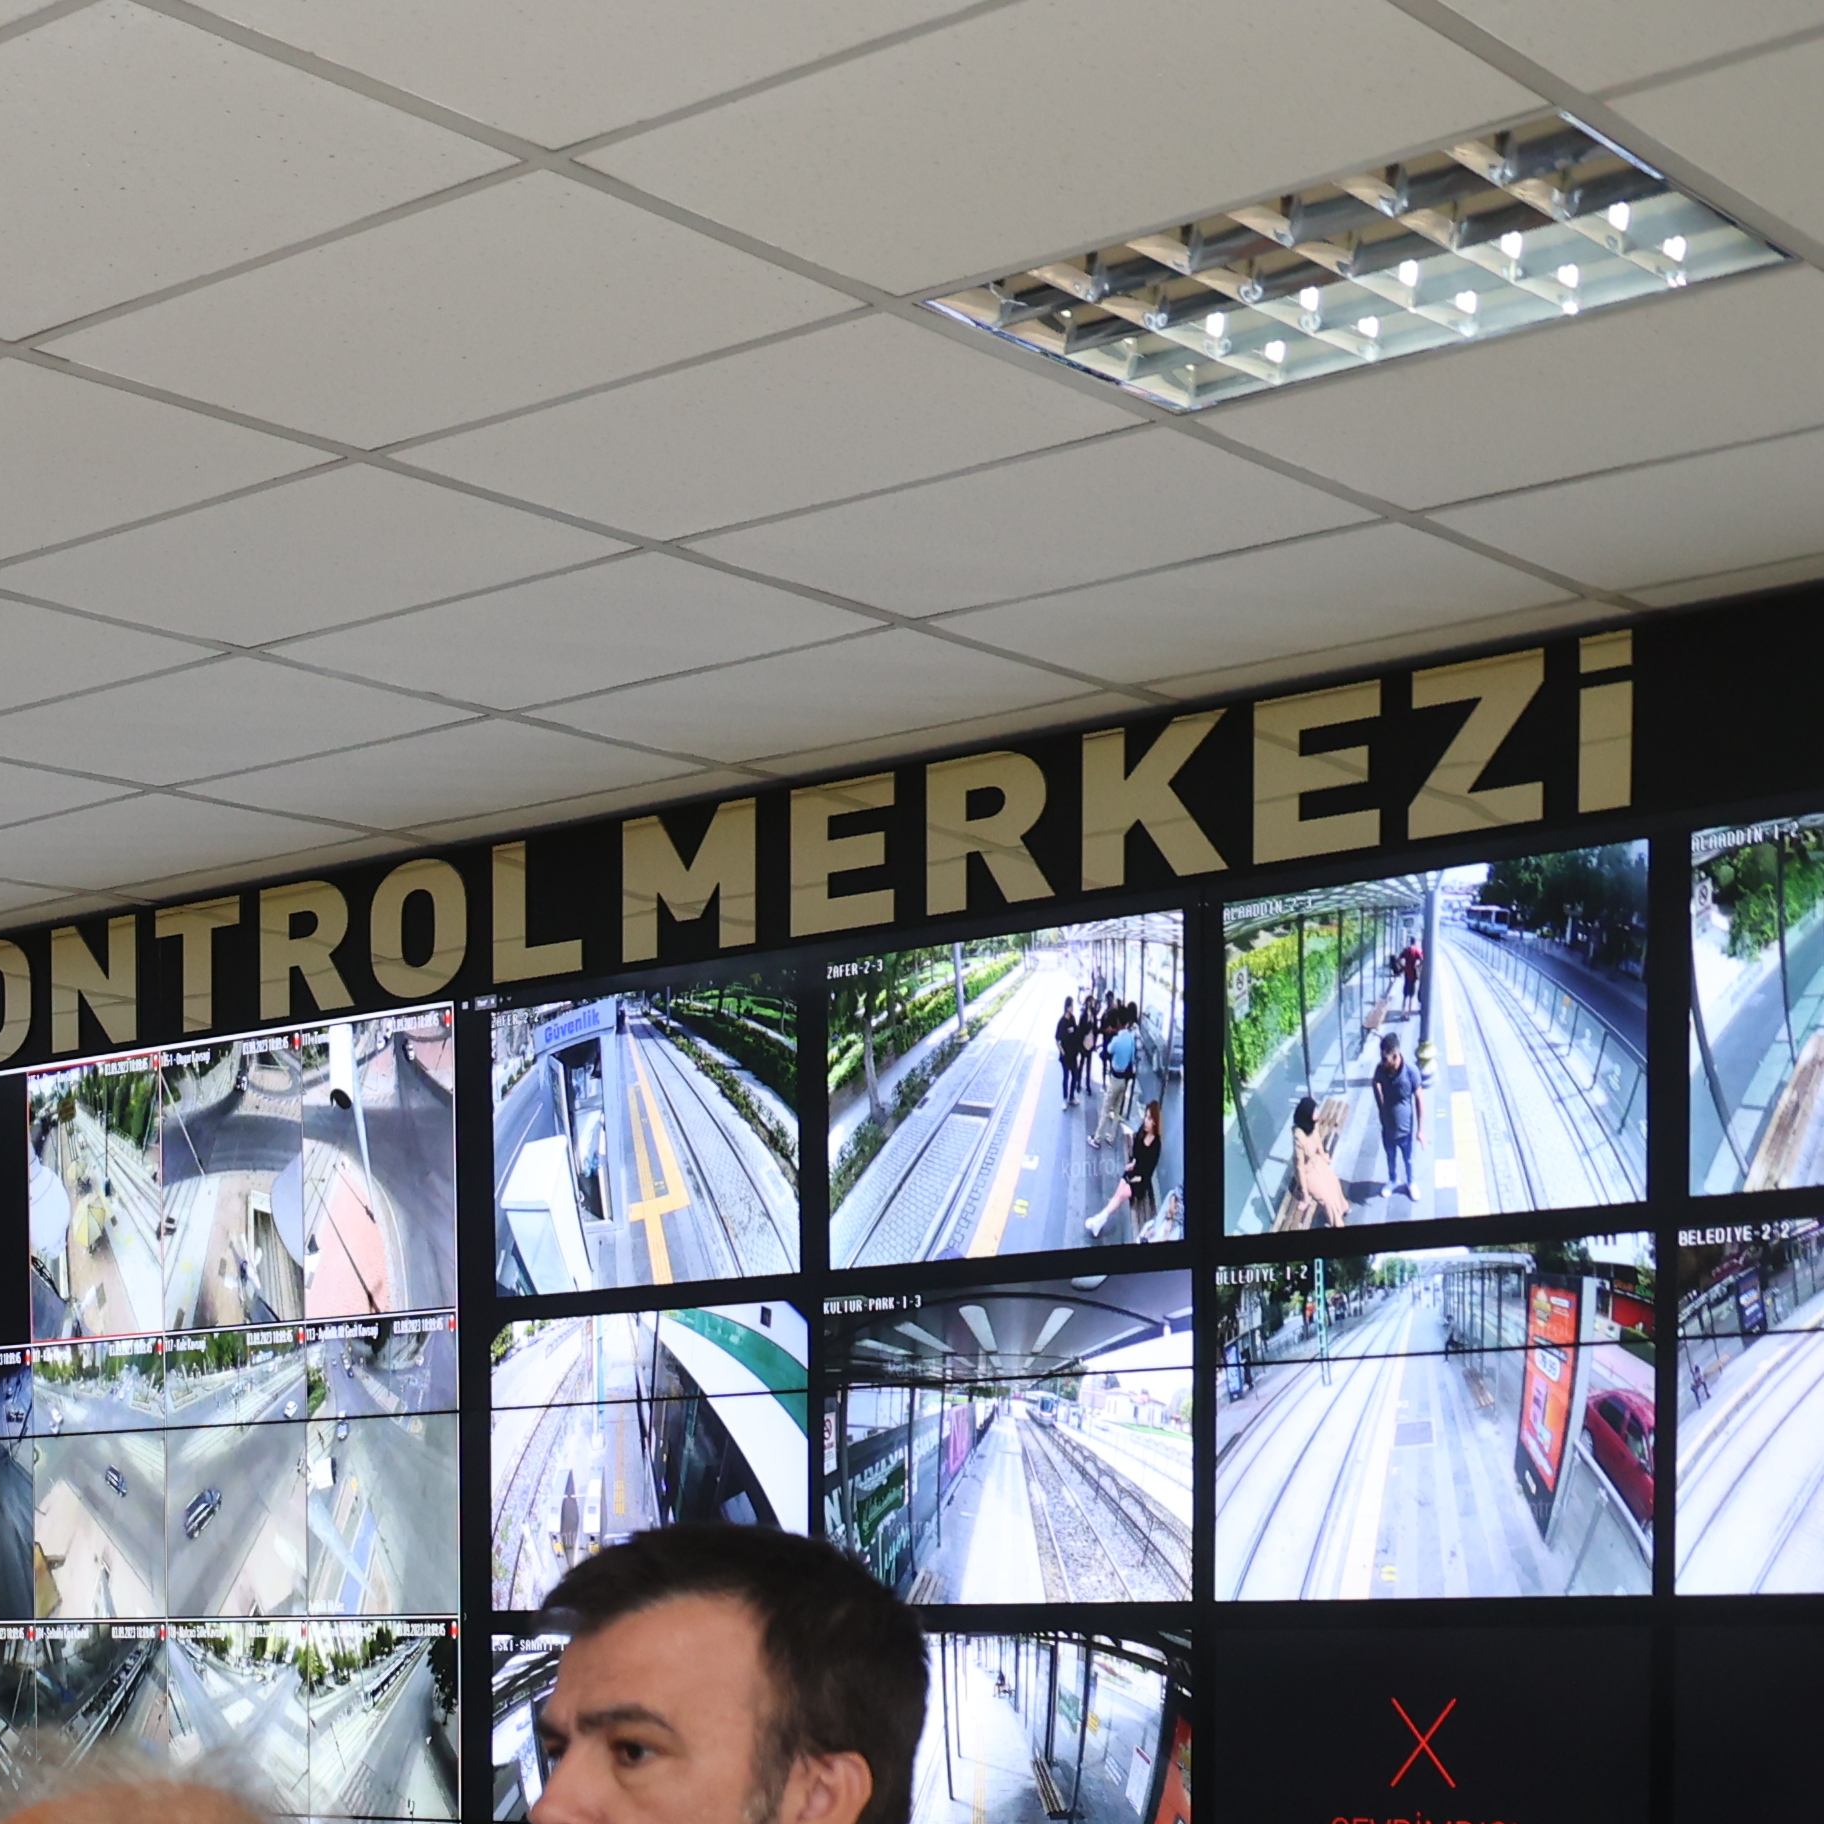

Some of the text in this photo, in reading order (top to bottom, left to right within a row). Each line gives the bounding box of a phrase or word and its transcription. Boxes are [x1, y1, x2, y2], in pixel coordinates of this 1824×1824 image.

[622, 630, 1634, 962] MERKEZİ
[827, 958, 883, 980] ZAFER-2-3
[545, 1009, 600, 1045] Güvenlik
[1678, 1222, 1790, 1247] BELEDIYE-2-2
[1215, 1265, 1308, 1286] BELEDIYE-1-2
